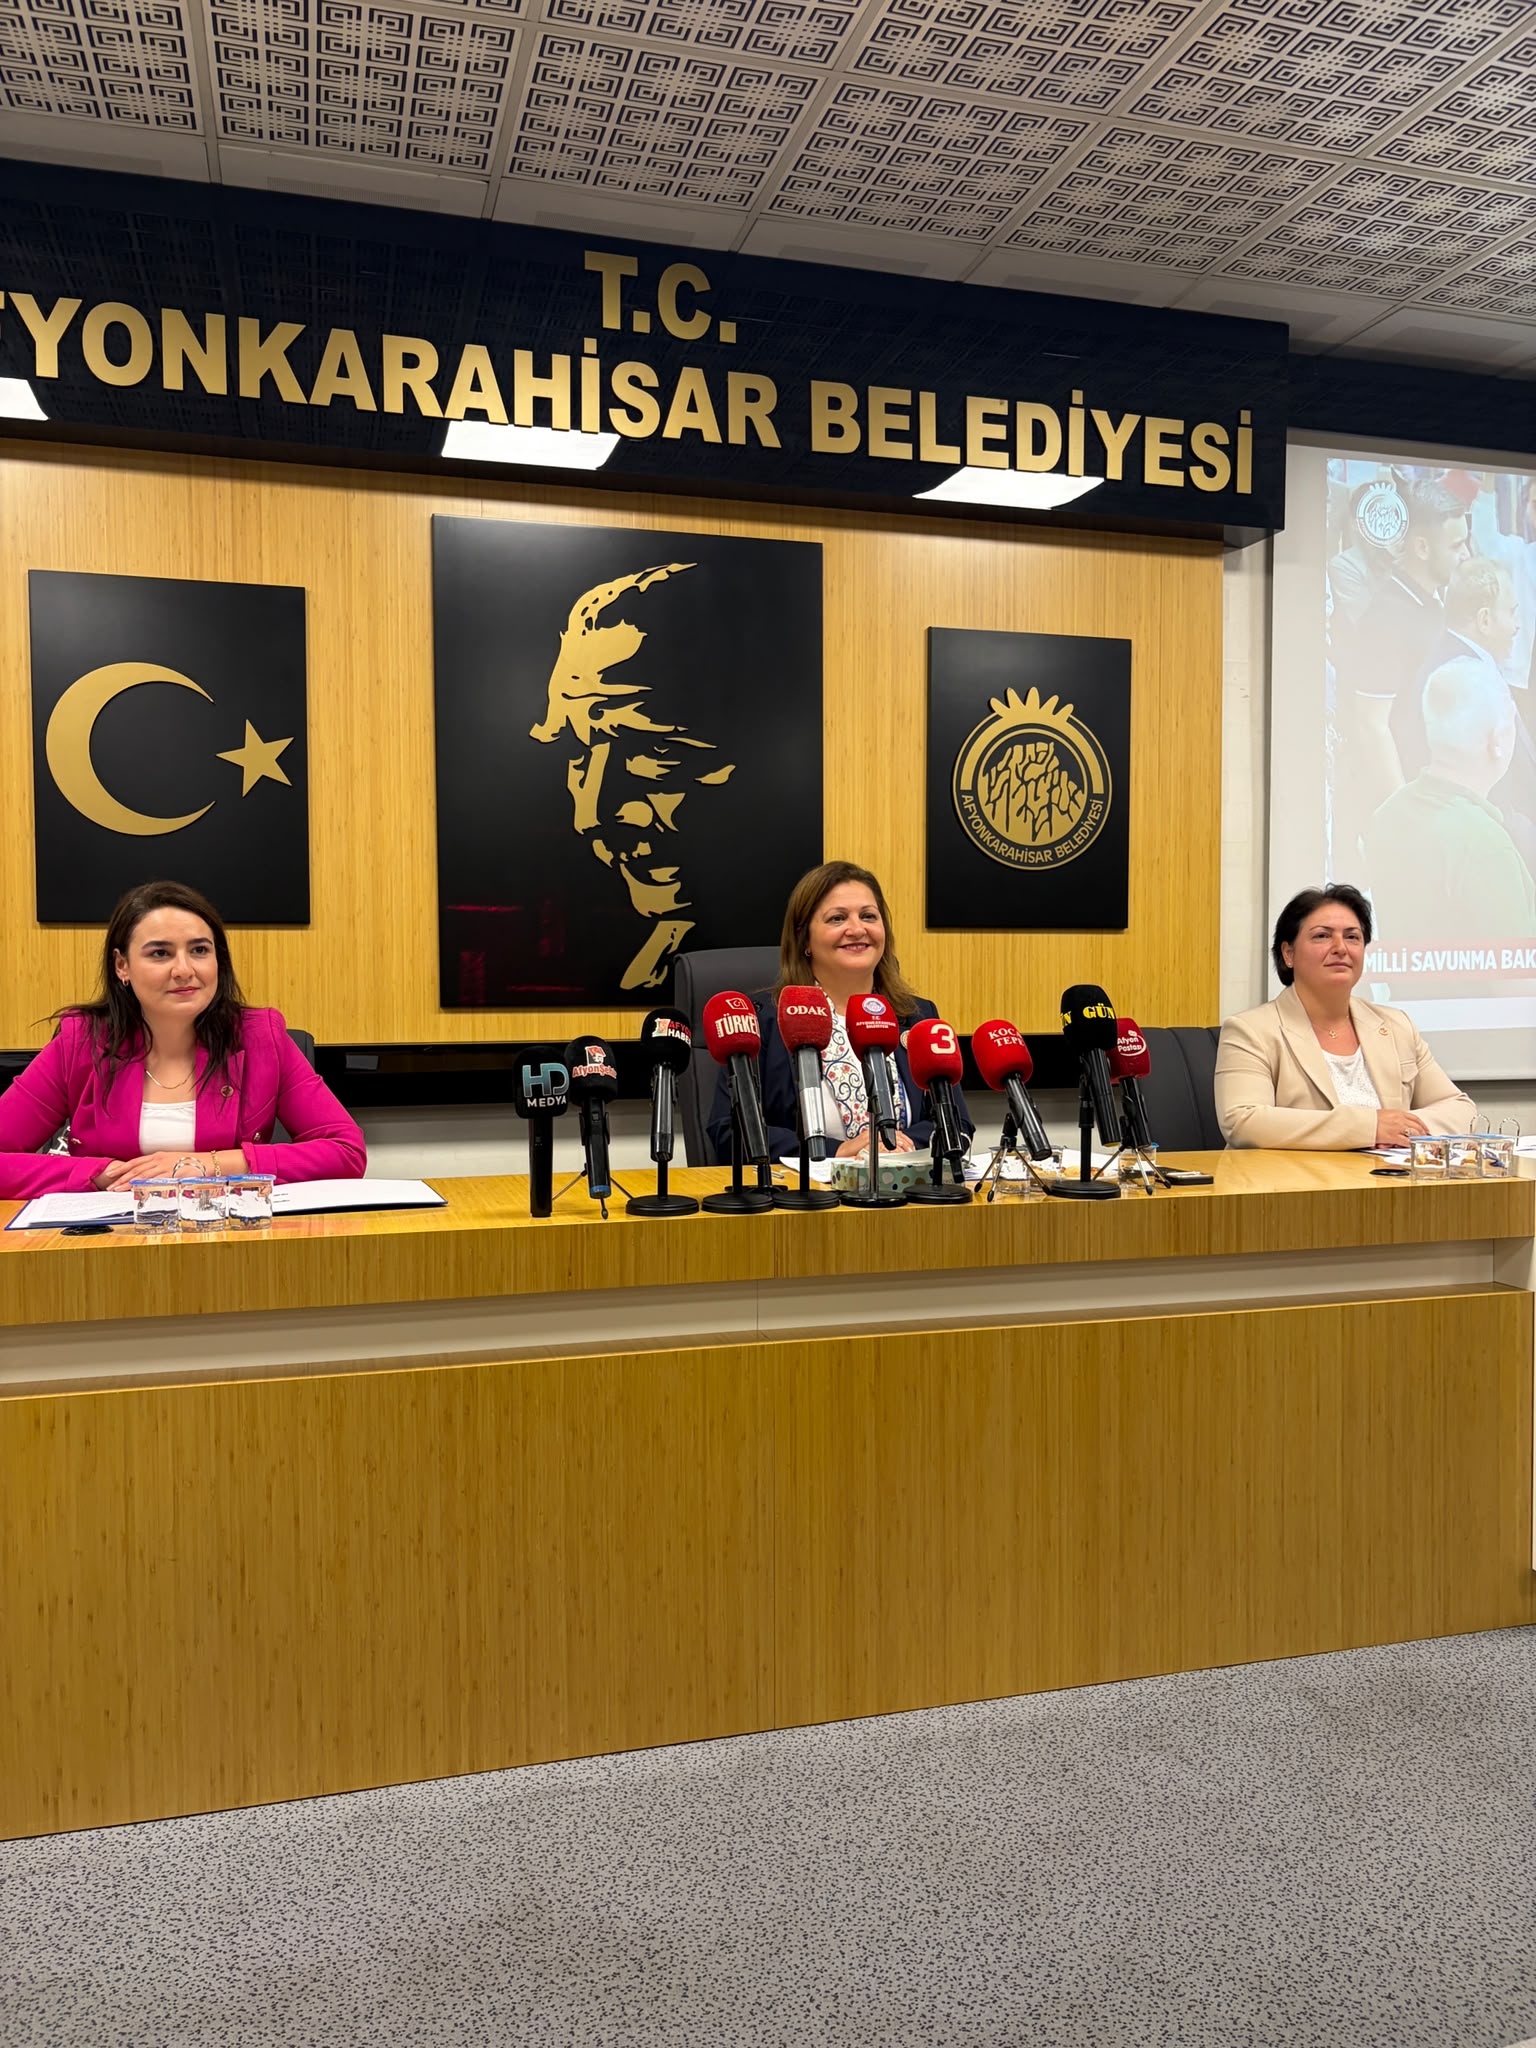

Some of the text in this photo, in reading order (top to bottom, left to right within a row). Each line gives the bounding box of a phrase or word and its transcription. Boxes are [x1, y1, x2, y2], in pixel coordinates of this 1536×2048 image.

[584, 250, 737, 344] T.C.
[0, 290, 1253, 495] YONKARAHİSAR BELEDİYESİ
[961, 794, 1104, 863] AFYONKARAHİSAR BELEDİYESİ
[1364, 948, 1407, 973] MİLLİ
[1411, 950, 1497, 972] SAVUNMA
[786, 1005, 828, 1017] ODAK
[1083, 1003, 1116, 1020] GÜN
[930, 1024, 956, 1055] 3
[1117, 1037, 1139, 1046] Afyon
[522, 1063, 570, 1097] HD
[527, 1096, 567, 1108] MEDYA
